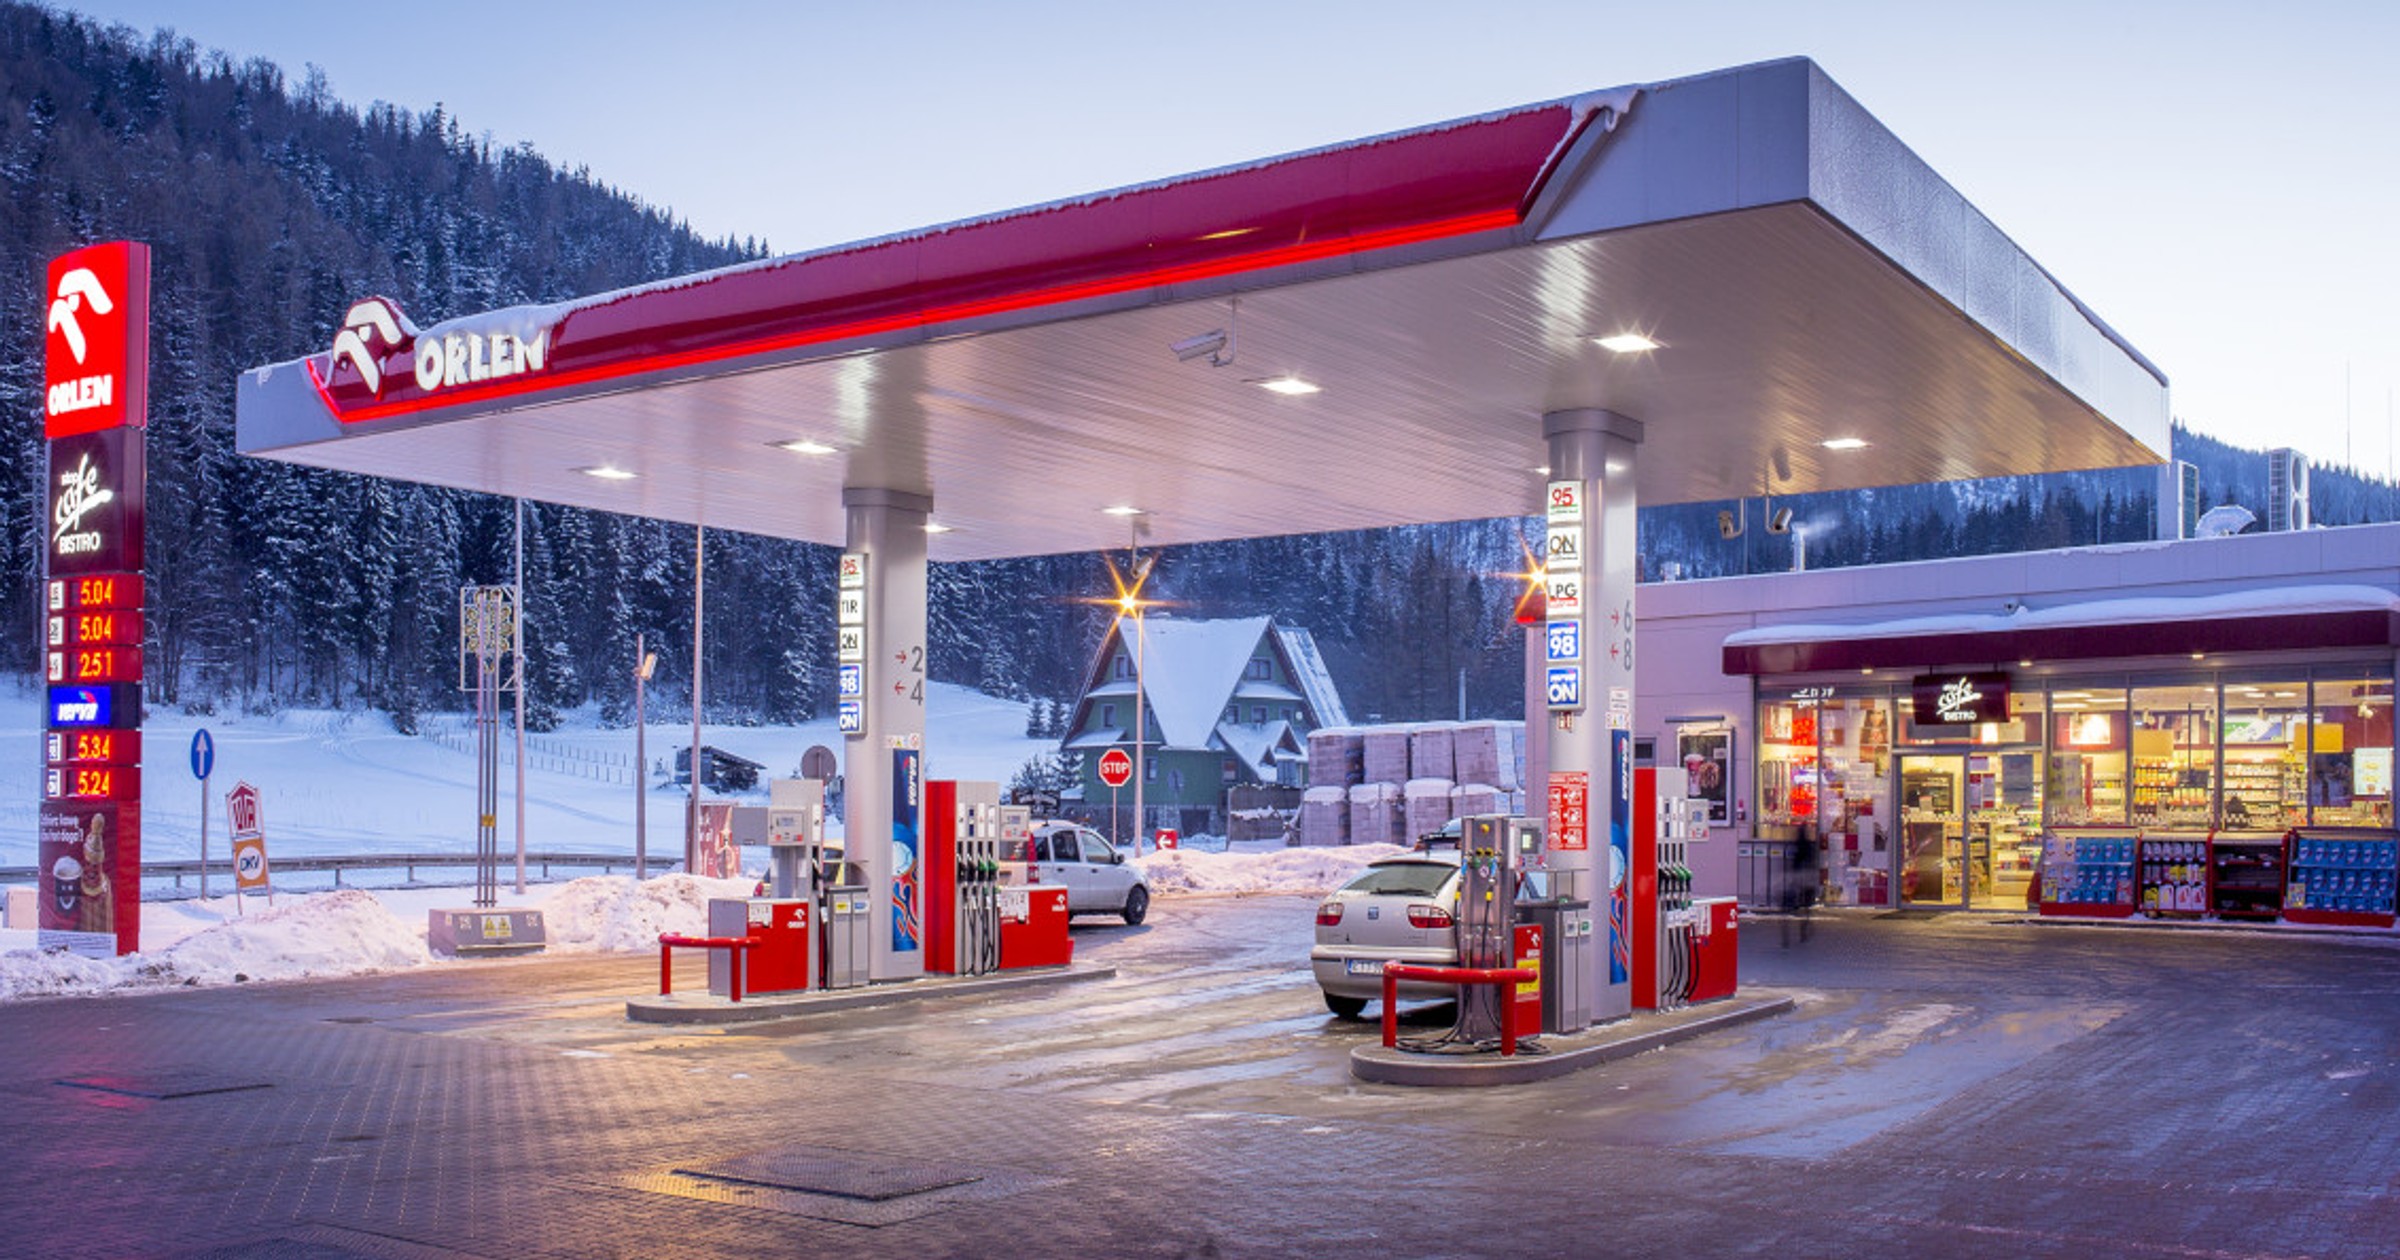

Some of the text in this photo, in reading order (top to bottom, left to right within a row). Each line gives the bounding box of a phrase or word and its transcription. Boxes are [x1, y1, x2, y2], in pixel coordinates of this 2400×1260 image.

[415, 330, 545, 392] ORLEN
[48, 373, 112, 417] ORLEN
[1552, 487, 1573, 507] 95
[59, 532, 101, 554] BISTRO
[80, 579, 113, 606] 5.04
[80, 615, 112, 641] 5.04
[912, 645, 924, 673] 2
[1550, 635, 1576, 657] 98
[1624, 638, 1632, 671] 8
[911, 679, 924, 706] 4
[1549, 683, 1577, 702] ON
[78, 734, 110, 760] 5.34
[1102, 762, 1130, 775] STOP
[78, 771, 110, 796] 5.24
